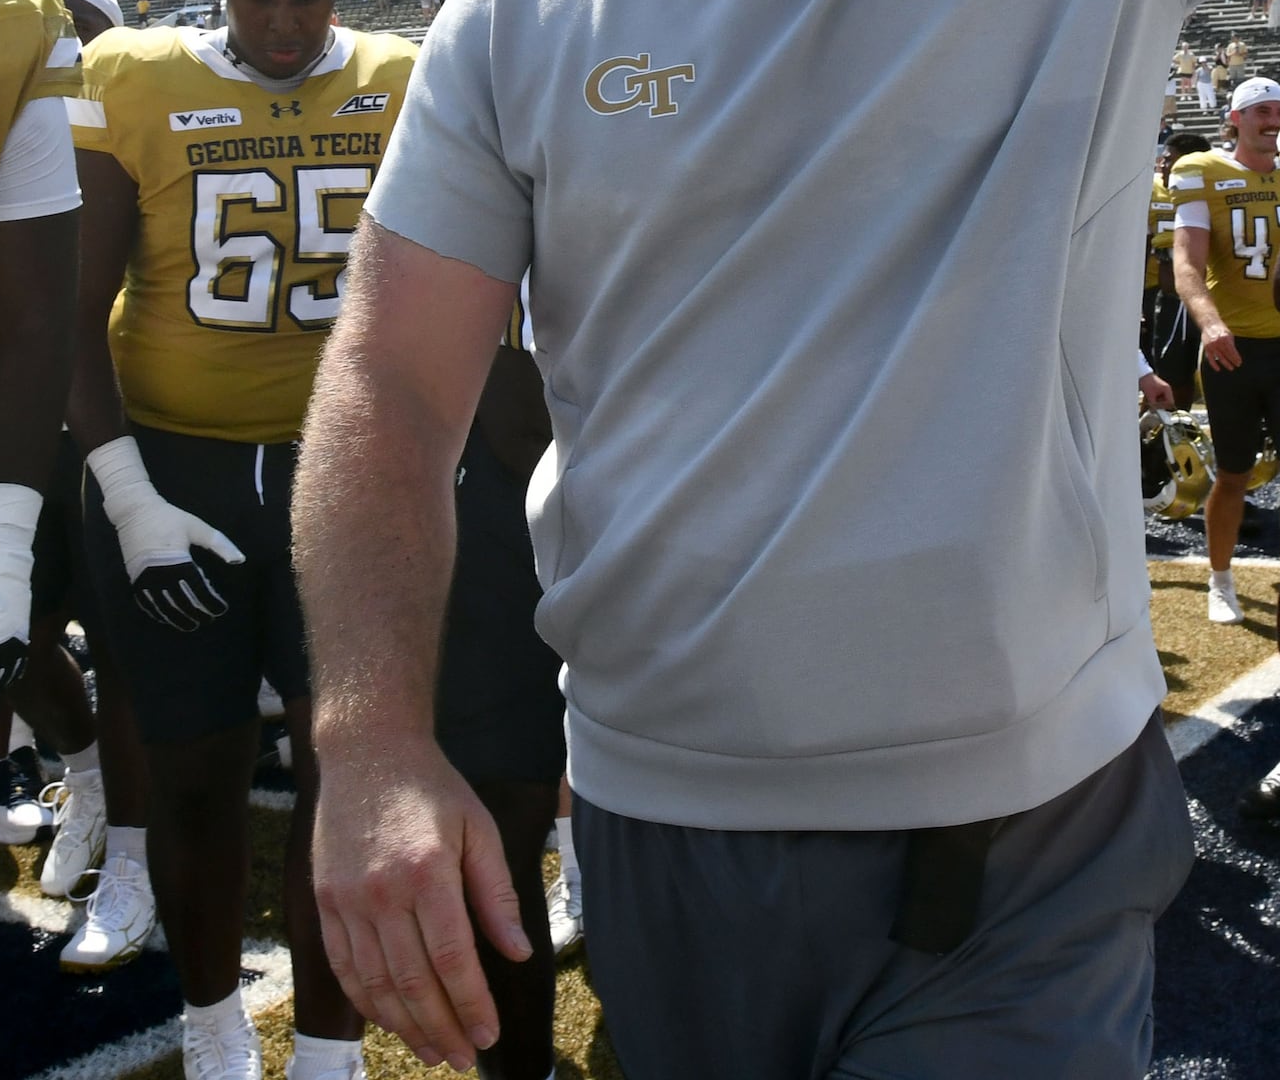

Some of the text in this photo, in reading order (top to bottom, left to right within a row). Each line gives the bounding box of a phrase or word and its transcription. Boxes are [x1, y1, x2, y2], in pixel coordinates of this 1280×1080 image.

[583, 53, 695, 118] GT
[340, 94, 388, 110] ACC
[196, 113, 237, 126] Veritiv
[187, 132, 382, 166] GEORGIA TECH
[1225, 191, 1278, 205] GEORGIA
[186, 164, 376, 333] 65
